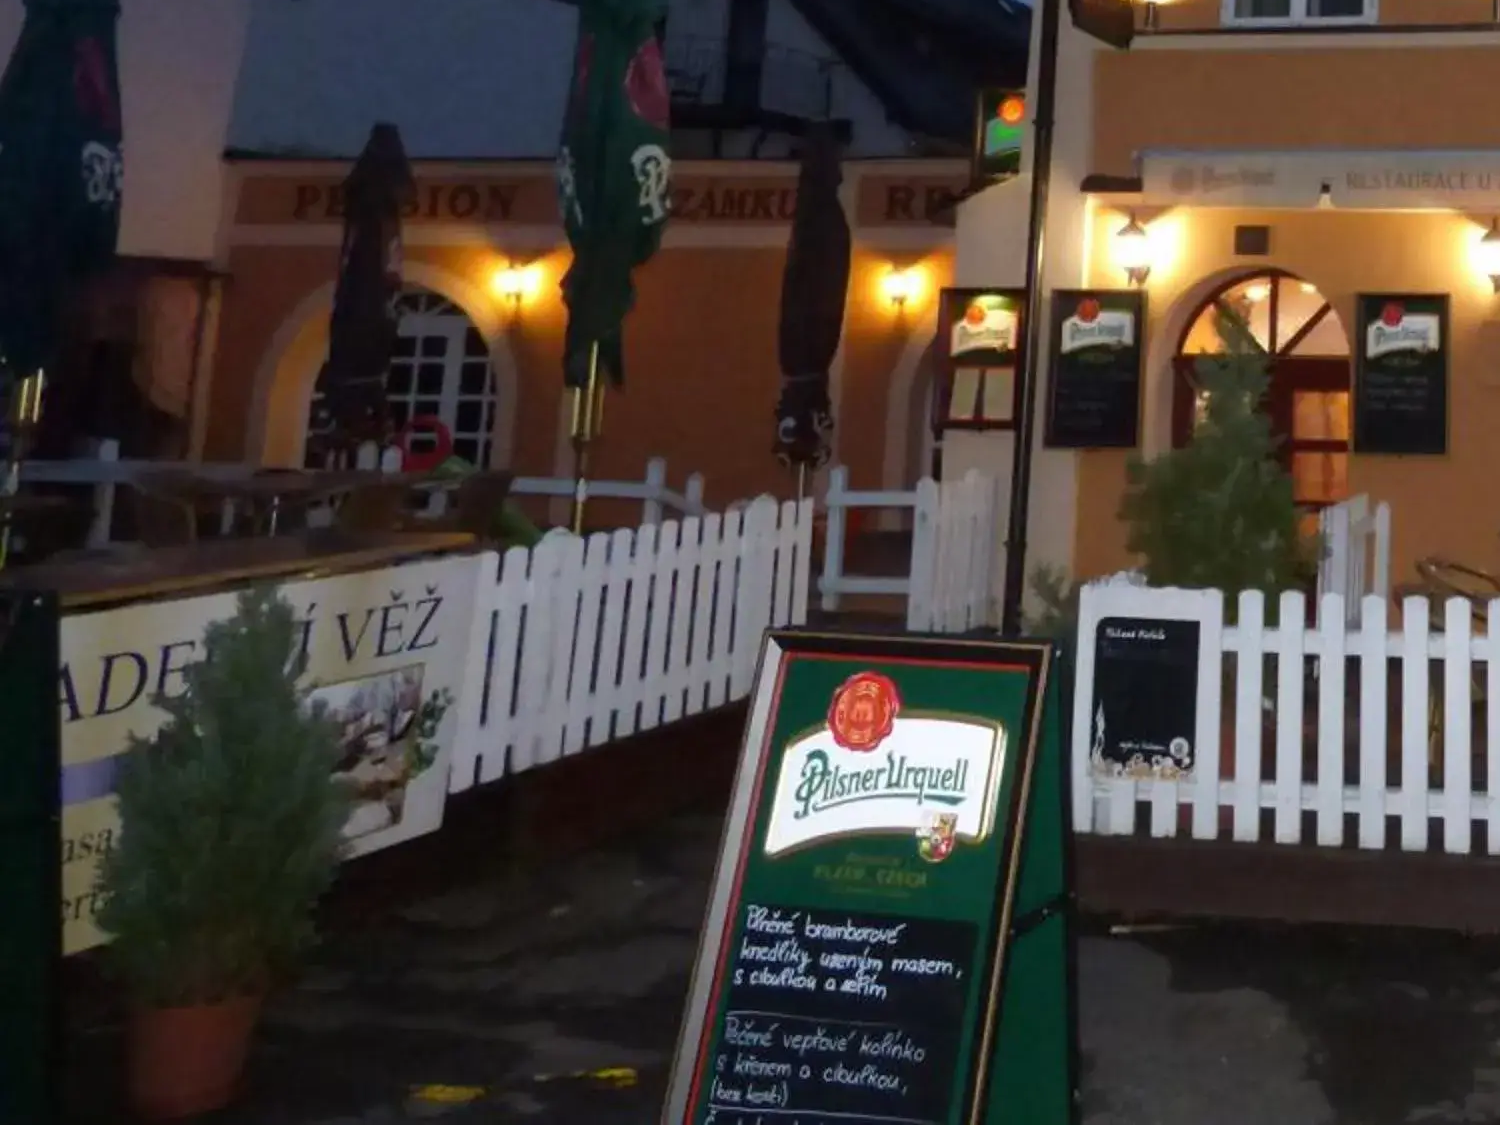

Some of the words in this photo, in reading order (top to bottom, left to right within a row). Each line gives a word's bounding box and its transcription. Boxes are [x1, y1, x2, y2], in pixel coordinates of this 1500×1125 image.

[336, 583, 444, 663] VĚŽ
[793, 749, 888, 819] Pilsner
[886, 751, 969, 805] Urquell
